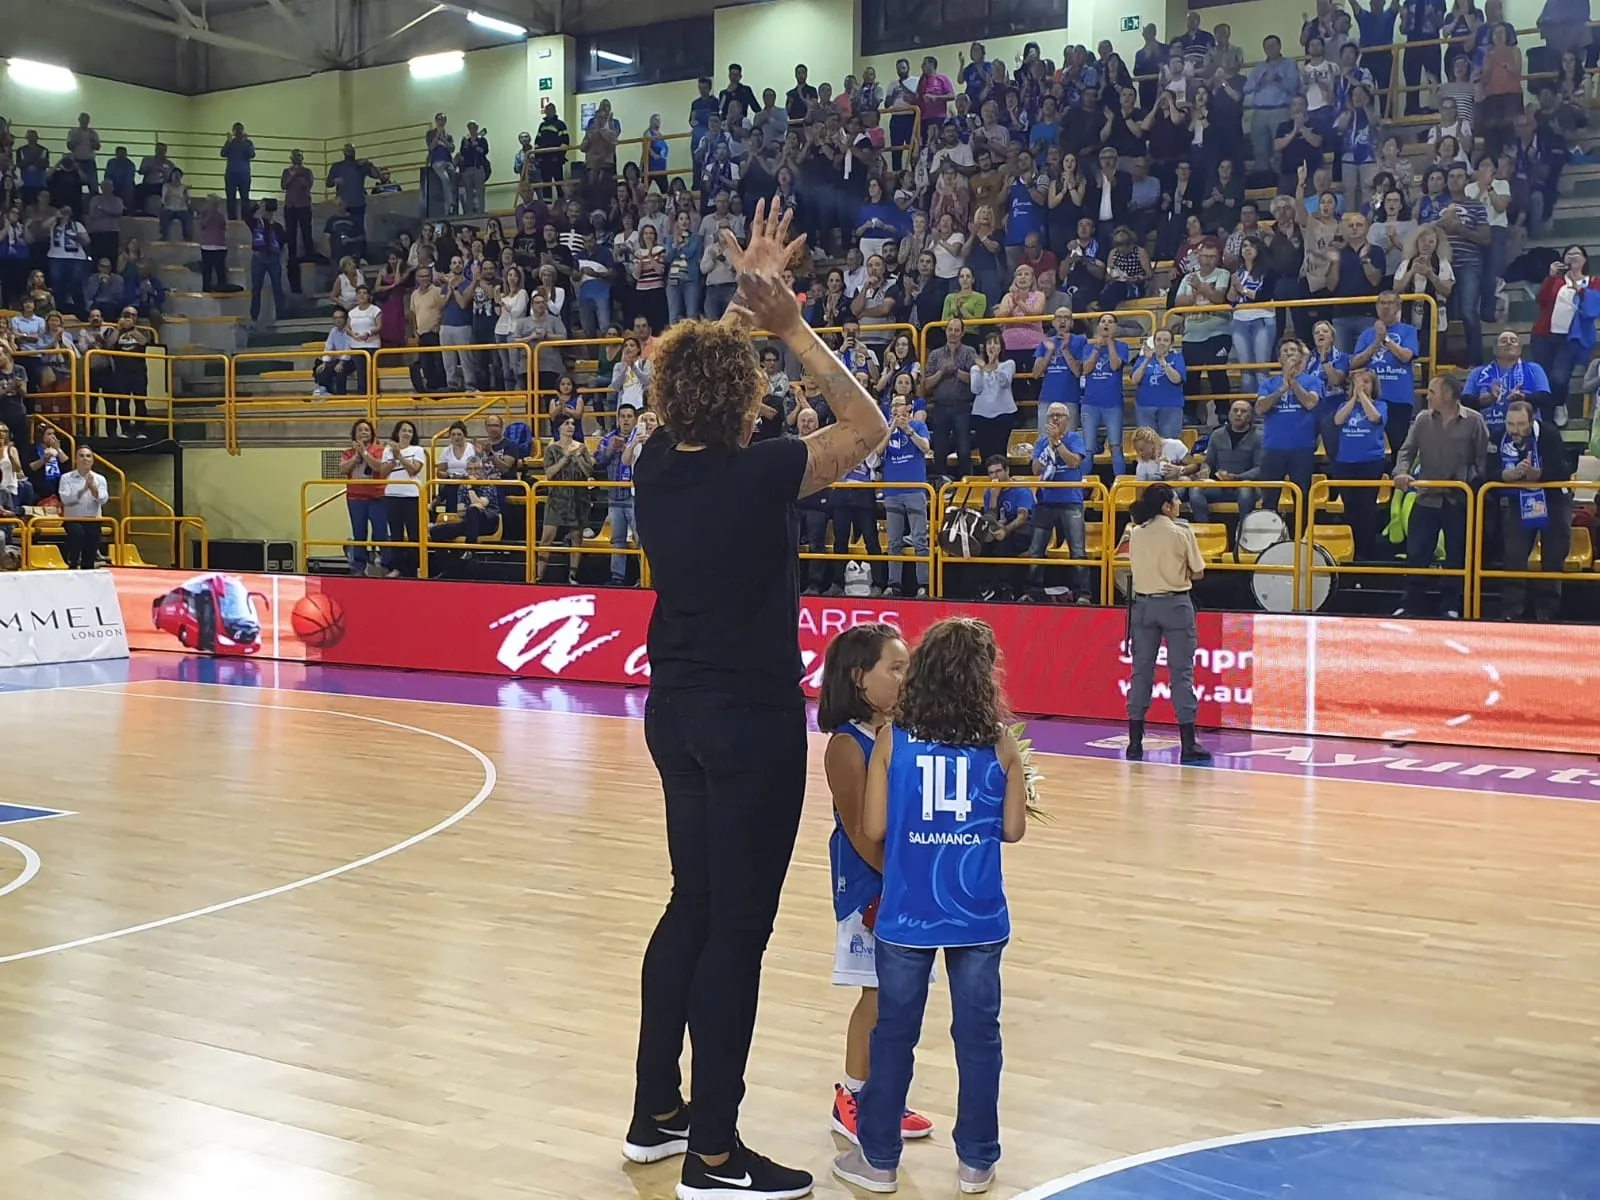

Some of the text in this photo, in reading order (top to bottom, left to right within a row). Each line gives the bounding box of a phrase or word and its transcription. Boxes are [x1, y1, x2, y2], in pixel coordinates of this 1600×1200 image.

[71, 628, 123, 641] LONDON
[916, 754, 972, 822] 14
[908, 831, 982, 846] SALAMANCA
